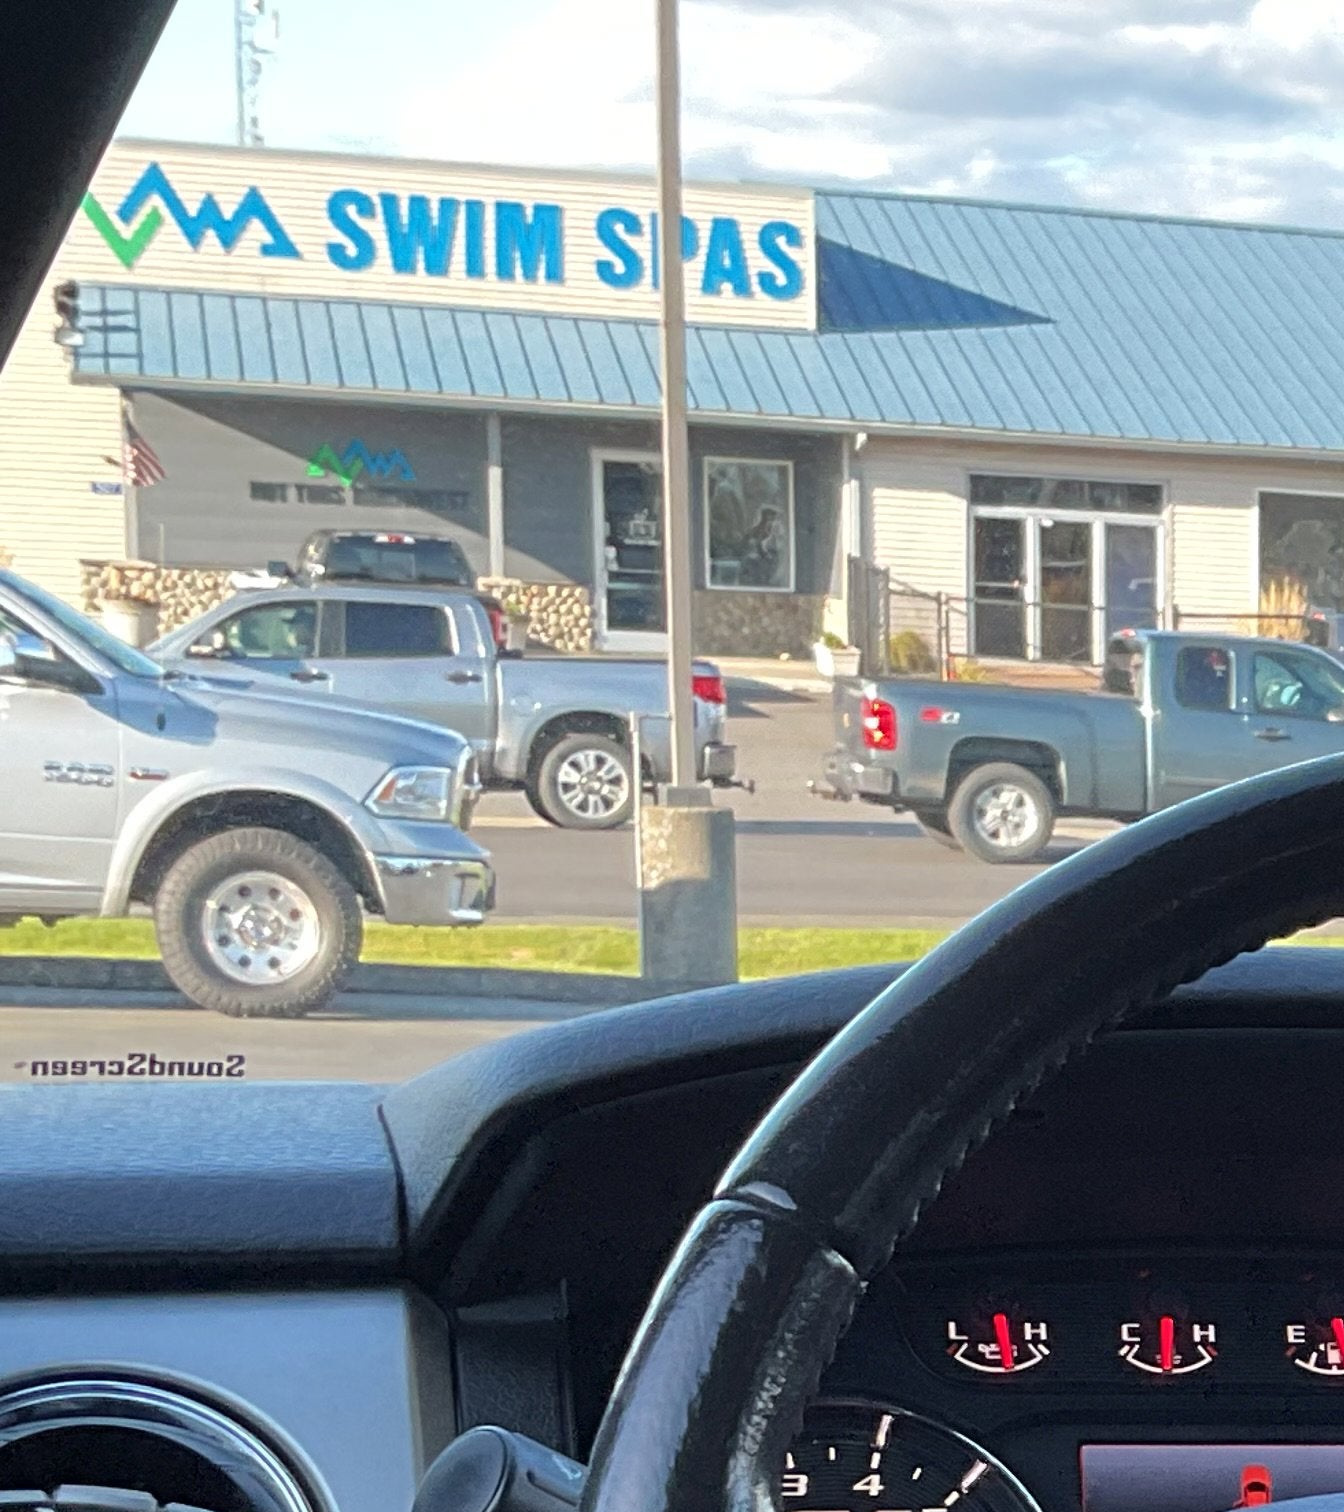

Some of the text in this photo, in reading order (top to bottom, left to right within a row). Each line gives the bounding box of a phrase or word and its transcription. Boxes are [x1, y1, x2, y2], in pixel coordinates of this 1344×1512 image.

[326, 188, 566, 285] SWIM
[948, 1322, 968, 1341] L
[1024, 1323, 1047, 1341] H
[1121, 1323, 1141, 1343] C
[1193, 1325, 1216, 1343] H
[1287, 1325, 1306, 1344] E
[781, 1474, 809, 1496] 3
[853, 1474, 885, 1497] 4
